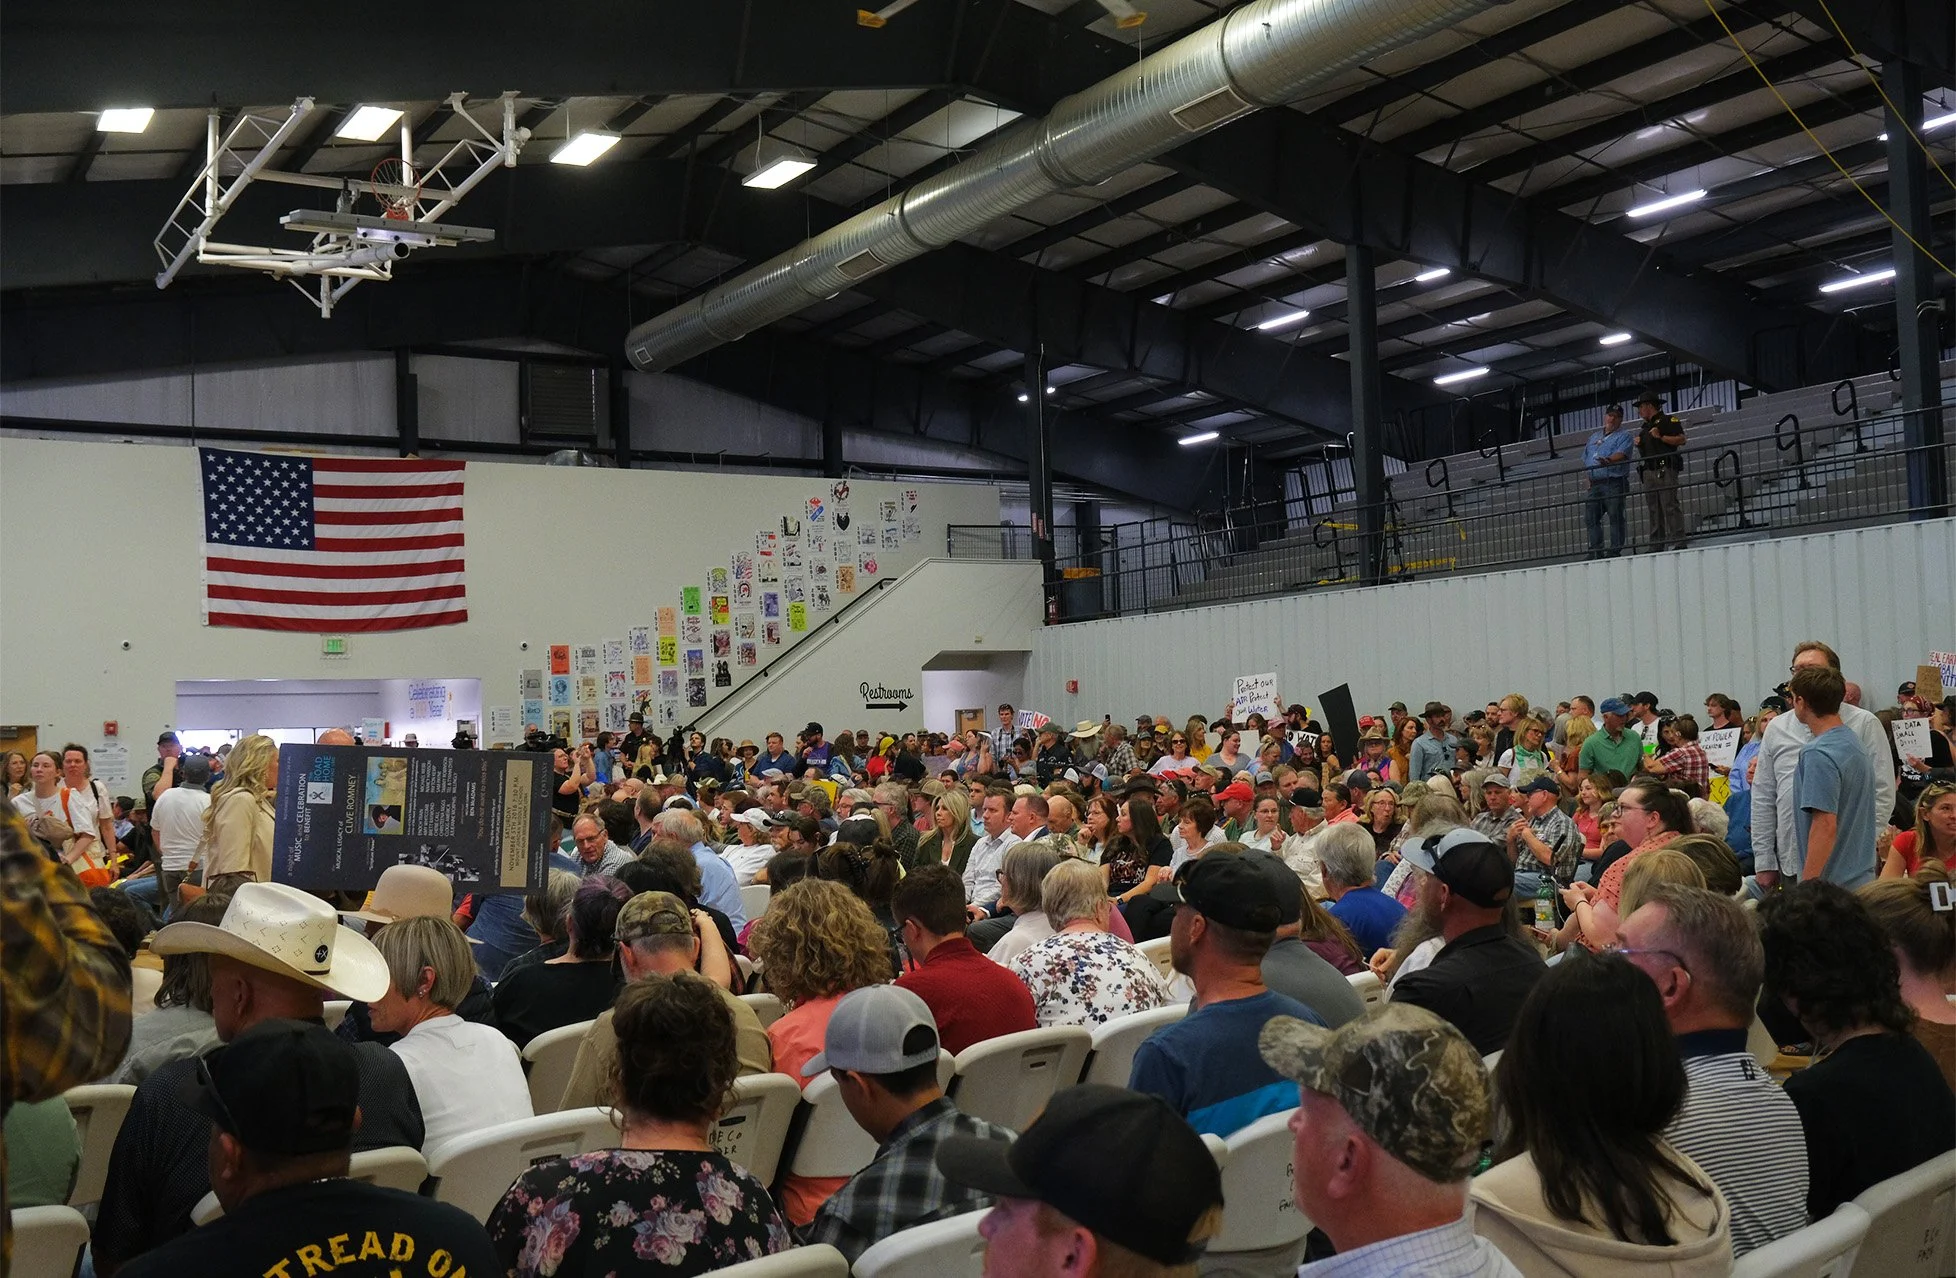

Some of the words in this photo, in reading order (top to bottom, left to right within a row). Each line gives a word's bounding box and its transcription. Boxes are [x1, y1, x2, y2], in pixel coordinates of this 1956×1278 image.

[860, 682, 914, 702] Restrooms
[1237, 678, 1258, 694] Protect
[1905, 721, 1921, 730] DATA
[314, 757, 322, 781] ROAD
[323, 756, 331, 781] HOME
[297, 774, 306, 823] CELEBRATION
[346, 775, 356, 810] ROMNEY
[345, 812, 354, 833] CLIVE
[294, 838, 302, 861] MUSIC
[264, 1231, 416, 1278] TREAD
